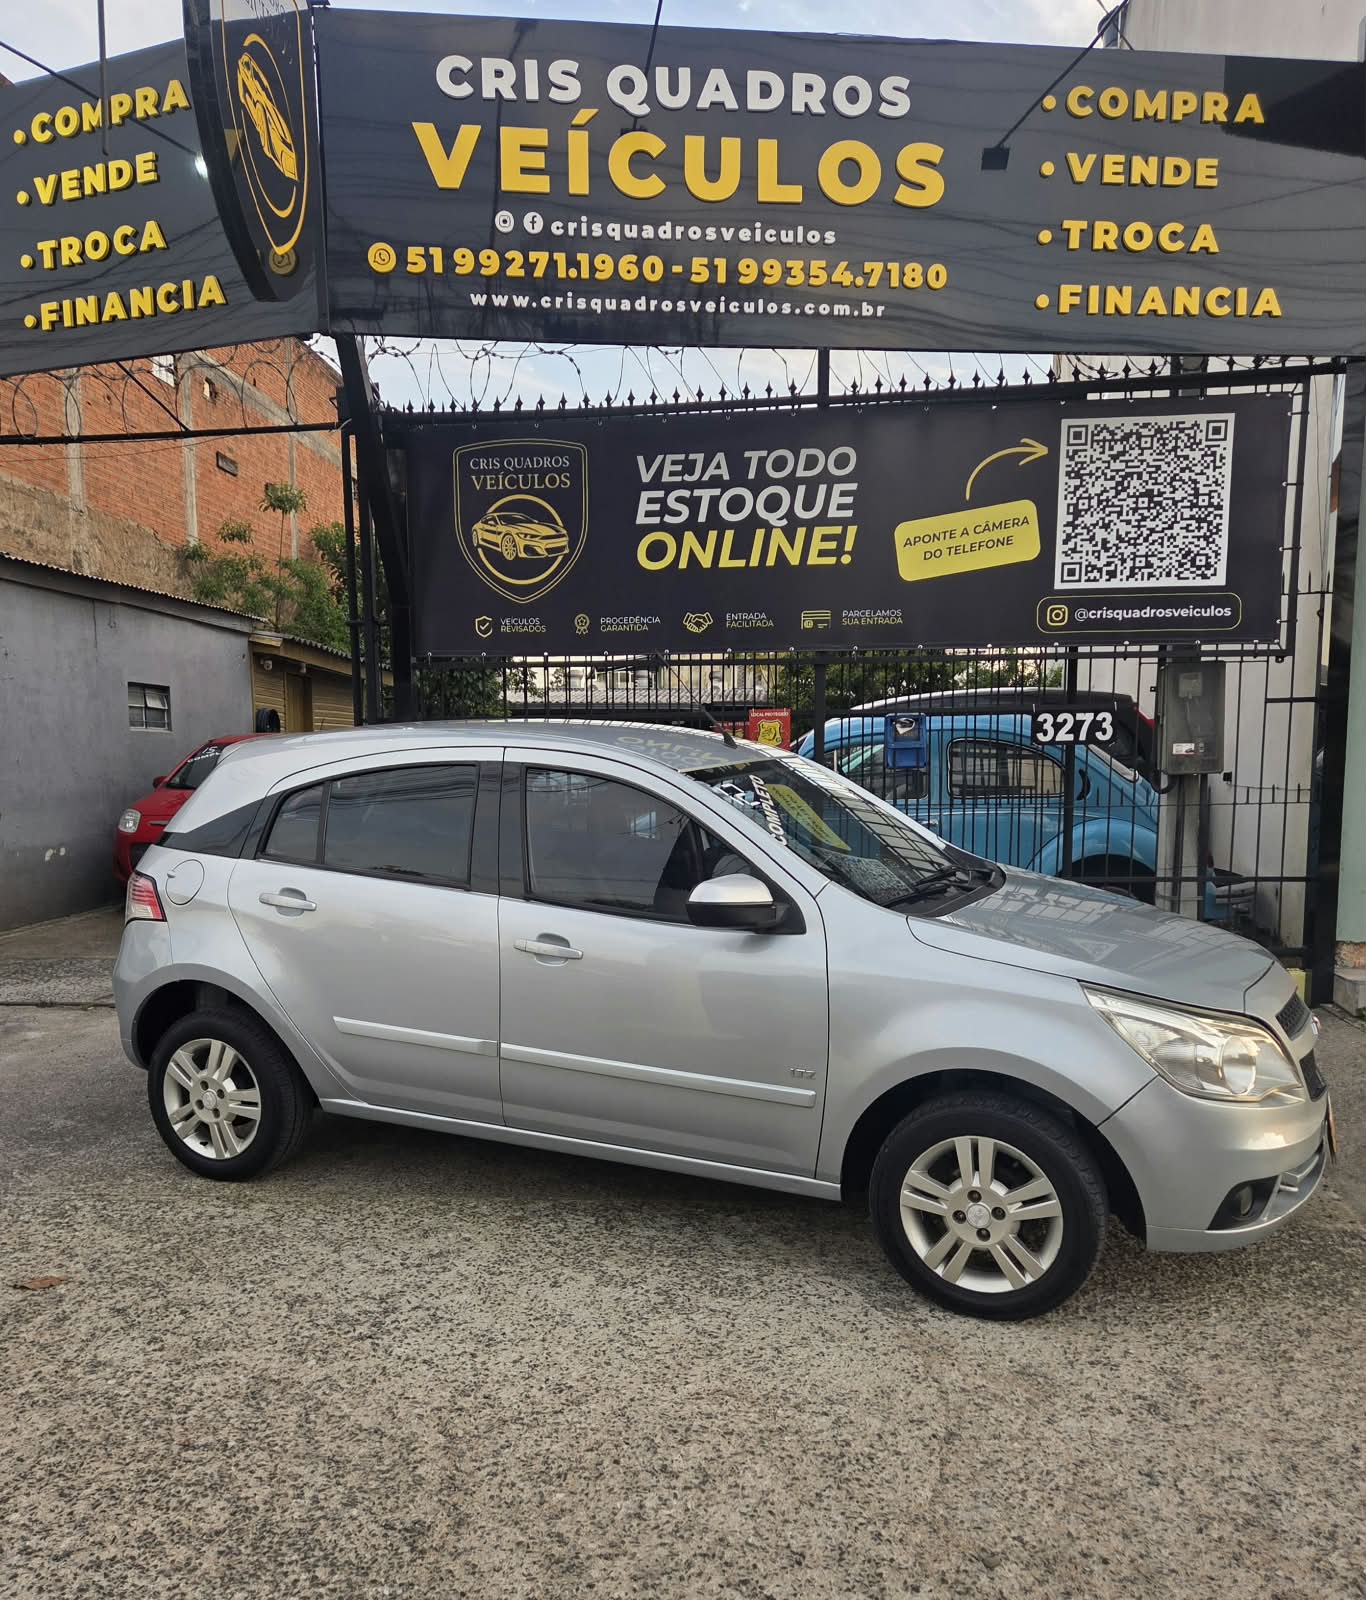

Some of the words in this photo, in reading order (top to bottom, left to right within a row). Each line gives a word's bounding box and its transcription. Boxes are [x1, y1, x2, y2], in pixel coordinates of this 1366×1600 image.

[435, 54, 582, 103] CRIS
[606, 64, 911, 118] QUADROS
[31, 79, 191, 144] COMPRA
[1066, 86, 1265, 124] COMPRA
[412, 108, 946, 208] VEÍCULOS
[1066, 152, 1220, 188] VENDE
[34, 151, 160, 206] VENDE
[37, 220, 168, 270] TROCA
[550, 215, 837, 244] crisquadrosveiculos
[1060, 219, 1220, 254] TROCA
[406, 246, 444, 274] 51
[453, 247, 664, 282] 99271.1960
[689, 256, 727, 284] 51
[737, 257, 948, 290] 99354.7180
[40, 275, 228, 331] FINANCIA
[470, 292, 886, 317] www.crisquadrosveiculos.com.br
[1057, 284, 1282, 318] FINANCIA
[470, 457, 500, 470] CRIS
[504, 455, 570, 471] QUADROS
[636, 452, 730, 483] VEJA
[744, 446, 857, 480] TODO
[471, 471, 571, 491] VEÍCULOS
[635, 482, 858, 527] ESTOQUE
[636, 525, 858, 571] ONLINE!
[903, 528, 957, 548] APONTE
[960, 527, 970, 538] A
[973, 515, 1030, 535] CÂMERA
[923, 548, 943, 561] DO
[946, 535, 1014, 557] TELEFONE
[500, 624, 547, 633] REVISADOS
[600, 624, 649, 632] GARANTIDA
[726, 612, 767, 621] ENTRADA
[726, 619, 774, 628] FACILITADA
[842, 609, 903, 618] PARCELAMOS
[842, 617, 860, 626] SUA
[861, 616, 903, 625] ENTRADA
[1074, 605, 1232, 622] @crisquadrosveiculos
[1036, 711, 1114, 742] 3273
[750, 774, 788, 846] COMPLETO
